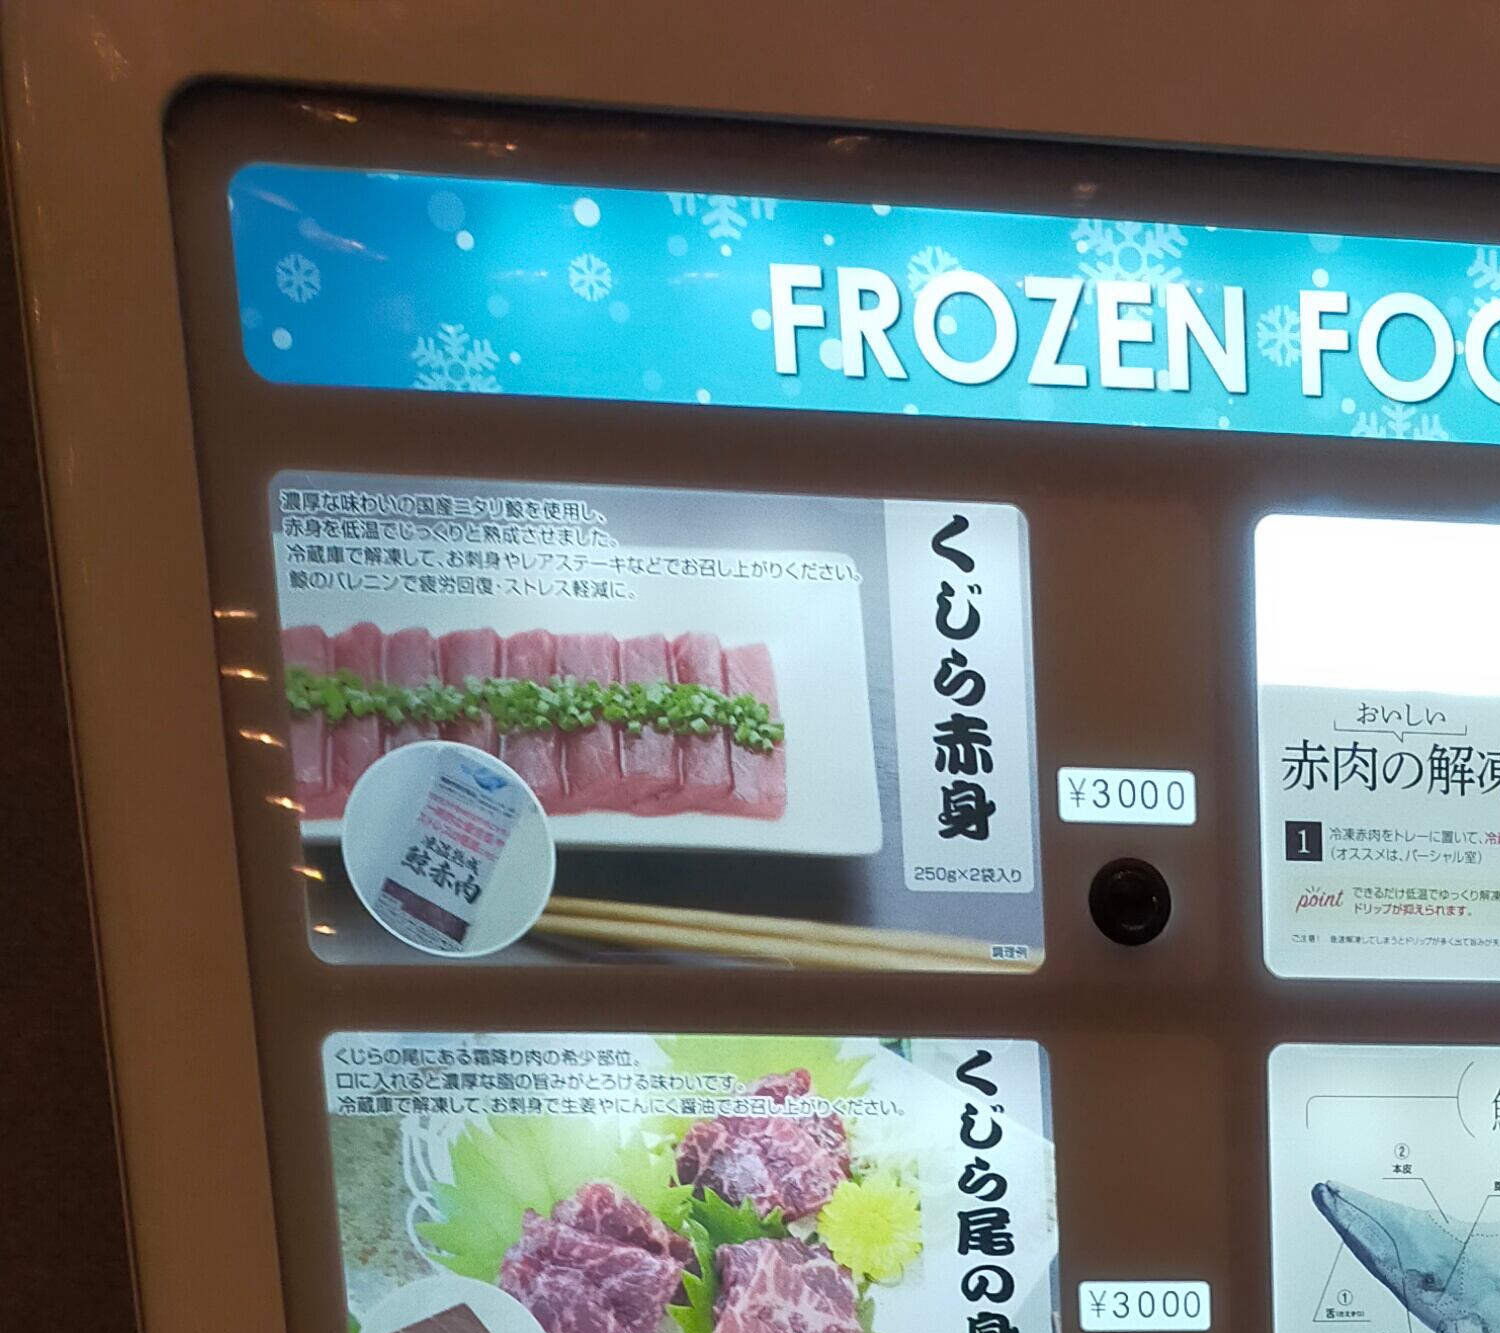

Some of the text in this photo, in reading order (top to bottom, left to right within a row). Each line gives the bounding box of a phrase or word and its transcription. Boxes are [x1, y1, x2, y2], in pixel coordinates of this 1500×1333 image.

[768, 263, 1247, 394] FROZEN
[284, 519, 618, 548] 赤身を低温でじっくりと熟成させました。
[931, 514, 996, 840] くじら赤身
[1357, 701, 1446, 726] おいしい
[1068, 777, 1185, 810] ¥3000
[1297, 829, 1311, 854] 1
[1296, 890, 1344, 913] point
[1354, 903, 1472, 917] ドリップが抑えられます。
[335, 1048, 640, 1067] くじらの尾にある霜降り肉の希少部位。
[336, 1072, 745, 1092] 口に入れると濃厚な脂の旨みがとろける味わいです。
[1089, 1290, 1202, 1319] ¥3000
